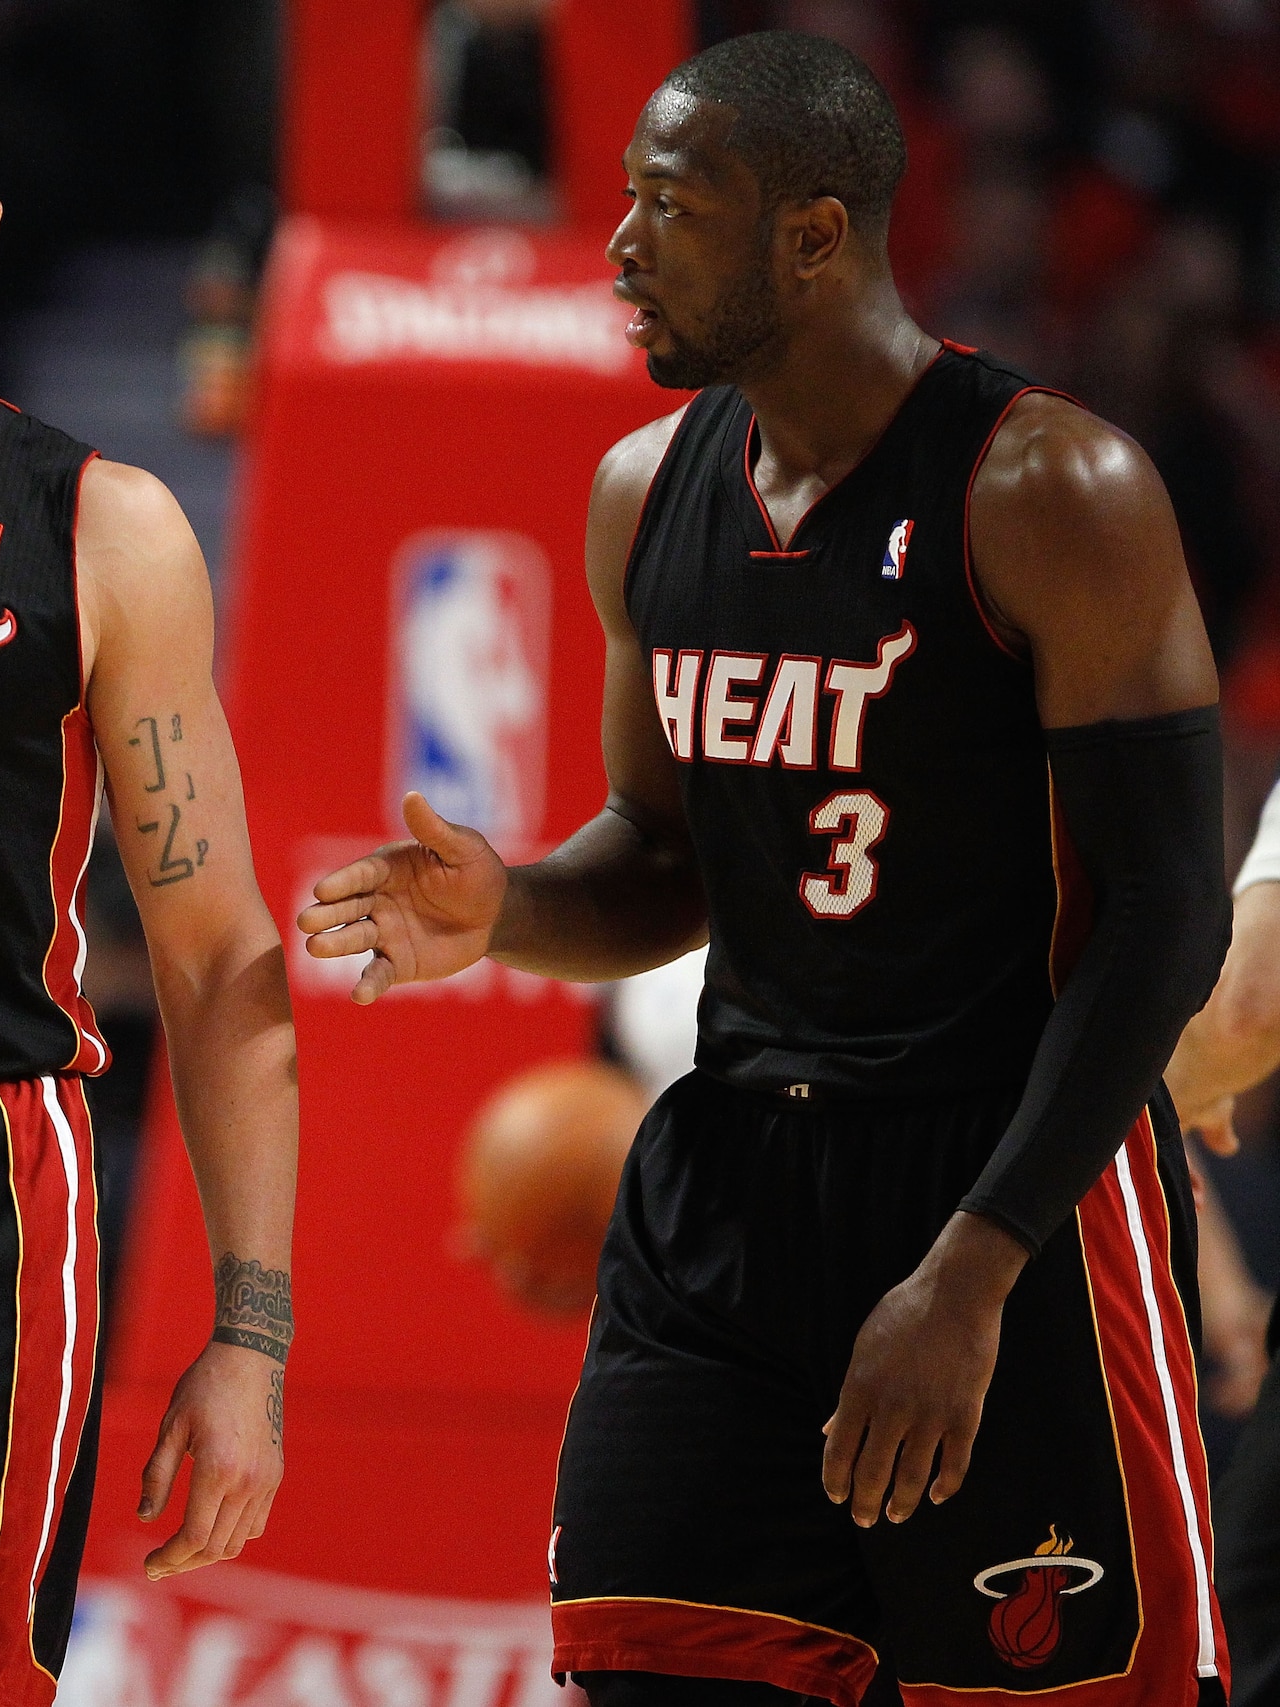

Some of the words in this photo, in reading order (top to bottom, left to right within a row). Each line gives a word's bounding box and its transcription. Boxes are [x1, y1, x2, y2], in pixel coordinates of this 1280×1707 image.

[881, 565, 896, 576] NBA
[652, 618, 918, 773] HEAT
[798, 788, 891, 920] 3
